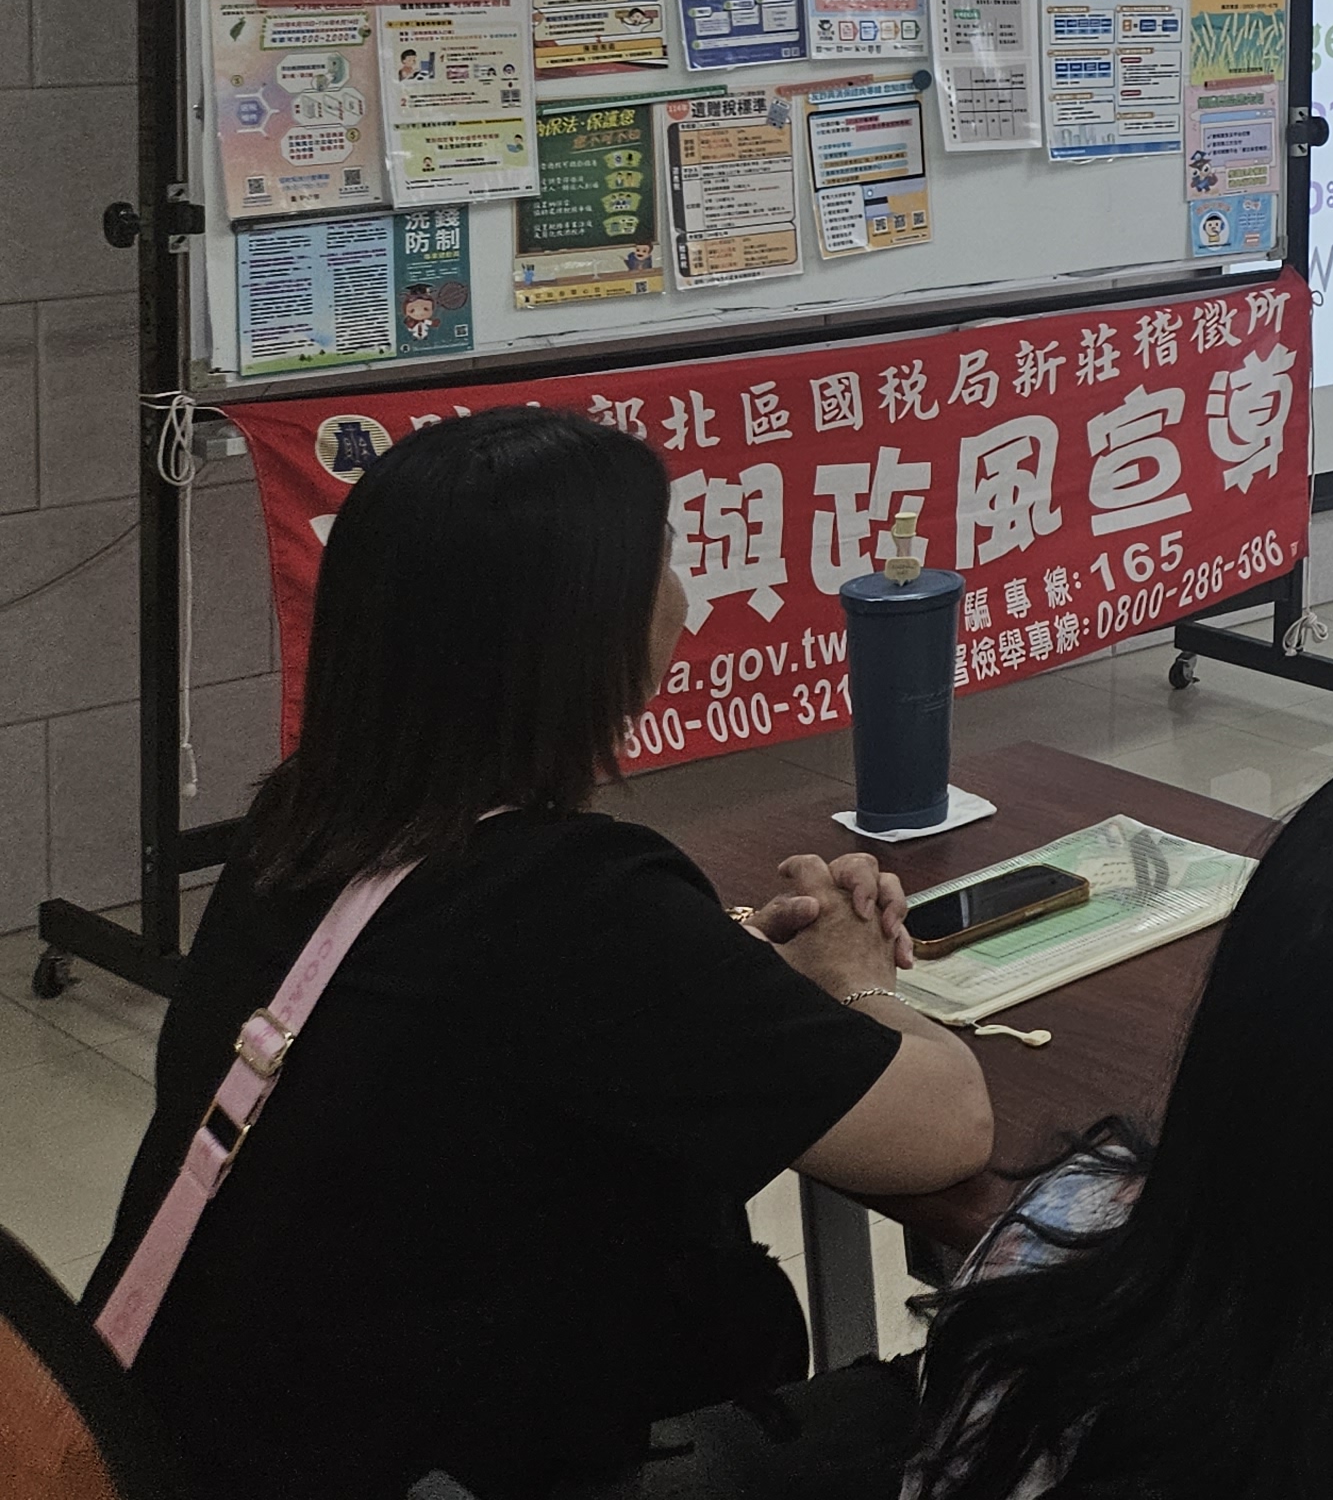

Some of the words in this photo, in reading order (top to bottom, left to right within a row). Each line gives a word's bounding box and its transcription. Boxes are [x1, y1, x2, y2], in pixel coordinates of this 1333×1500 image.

[691, 98, 767, 118] 遺贈稅標準
[405, 229, 460, 254] 防制
[411, 288, 1291, 451] 部北區國稅局新莊稽徵所
[310, 342, 1297, 636] 與政風宣導
[656, 627, 848, 698] a.gov.tw
[625, 674, 853, 759] 800-000-321
